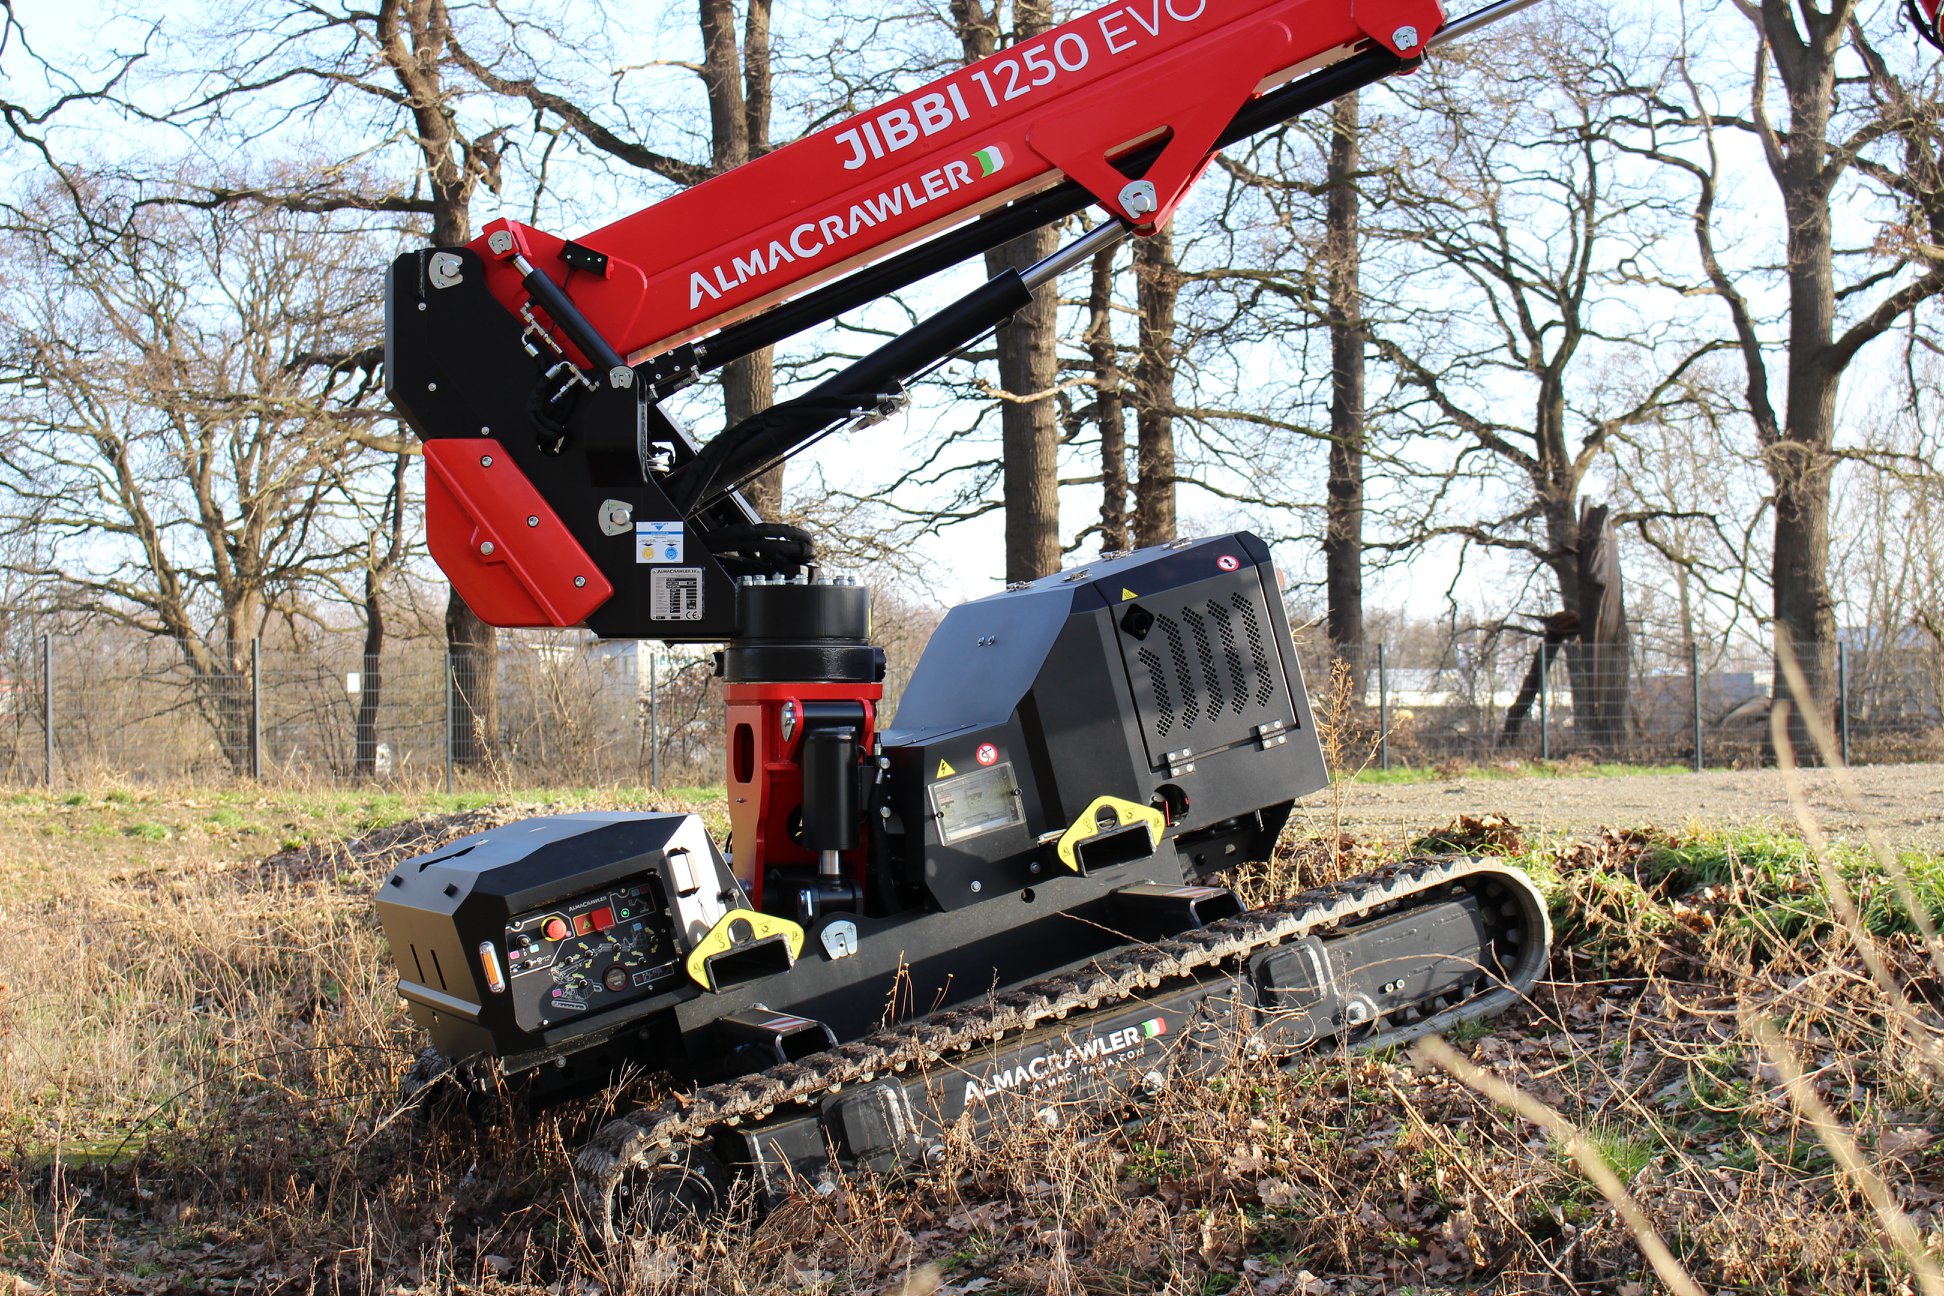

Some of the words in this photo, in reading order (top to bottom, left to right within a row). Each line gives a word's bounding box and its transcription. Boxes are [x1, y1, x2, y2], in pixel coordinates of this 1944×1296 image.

[834, 83, 971, 170] JIBBI
[971, 32, 1090, 108] 1250
[1097, 0, 1206, 55] EVO
[690, 160, 974, 310] ALMACRAWLER
